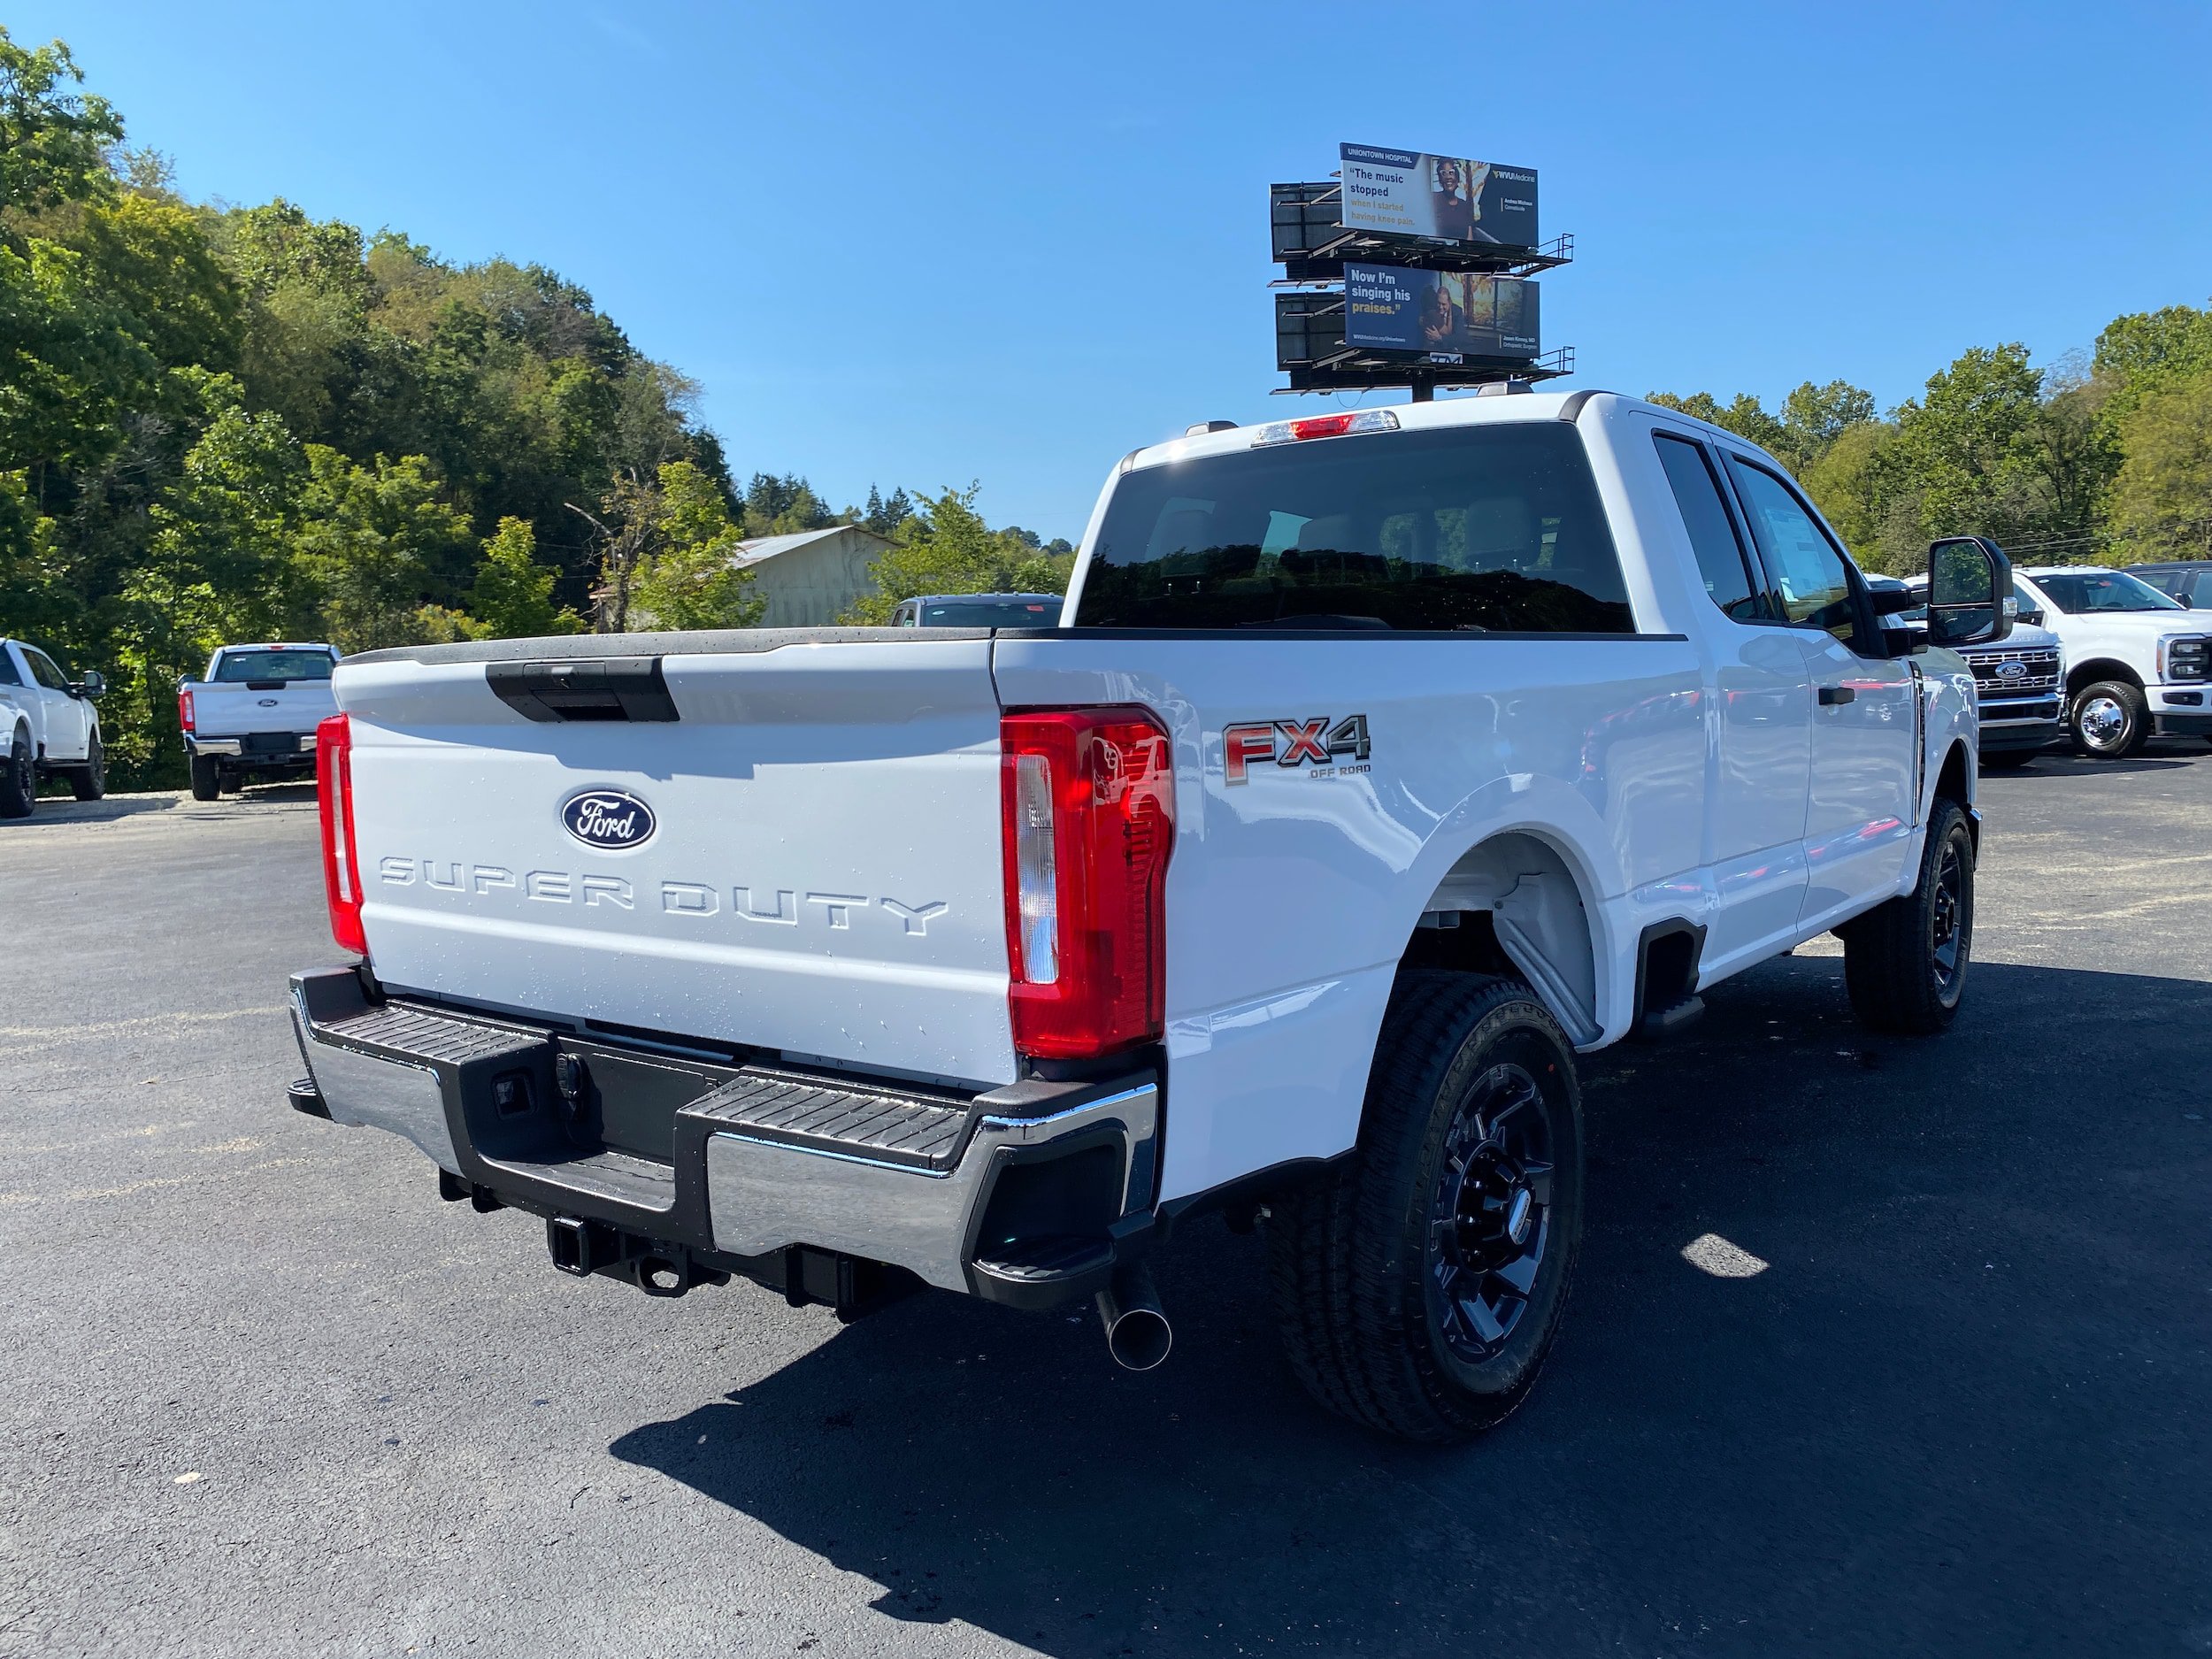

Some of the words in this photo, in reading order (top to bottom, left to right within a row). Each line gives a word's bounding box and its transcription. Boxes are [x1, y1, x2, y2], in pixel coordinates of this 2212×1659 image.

[1348, 148, 1384, 160] UNIONTOWN
[1385, 153, 1412, 164] HOSPITAL
[1376, 173, 1404, 183] music
[1350, 183, 1389, 197] stopped
[1351, 198, 1371, 209] when
[1378, 202, 1404, 212] started
[1351, 211, 1376, 224] having
[1378, 214, 1395, 224] knee
[1397, 216, 1415, 227] pain.
[1351, 269, 1377, 283] Now
[1379, 272, 1395, 284] I’m
[1351, 286, 1392, 302] singing
[1394, 288, 1410, 302] his
[1222, 713, 1371, 787] FX4
[1310, 767, 1335, 779] OFF
[1340, 764, 1371, 776] ROAD
[576, 797, 636, 840] Ford
[380, 856, 634, 910] SUPER
[662, 881, 949, 936] DUTY
